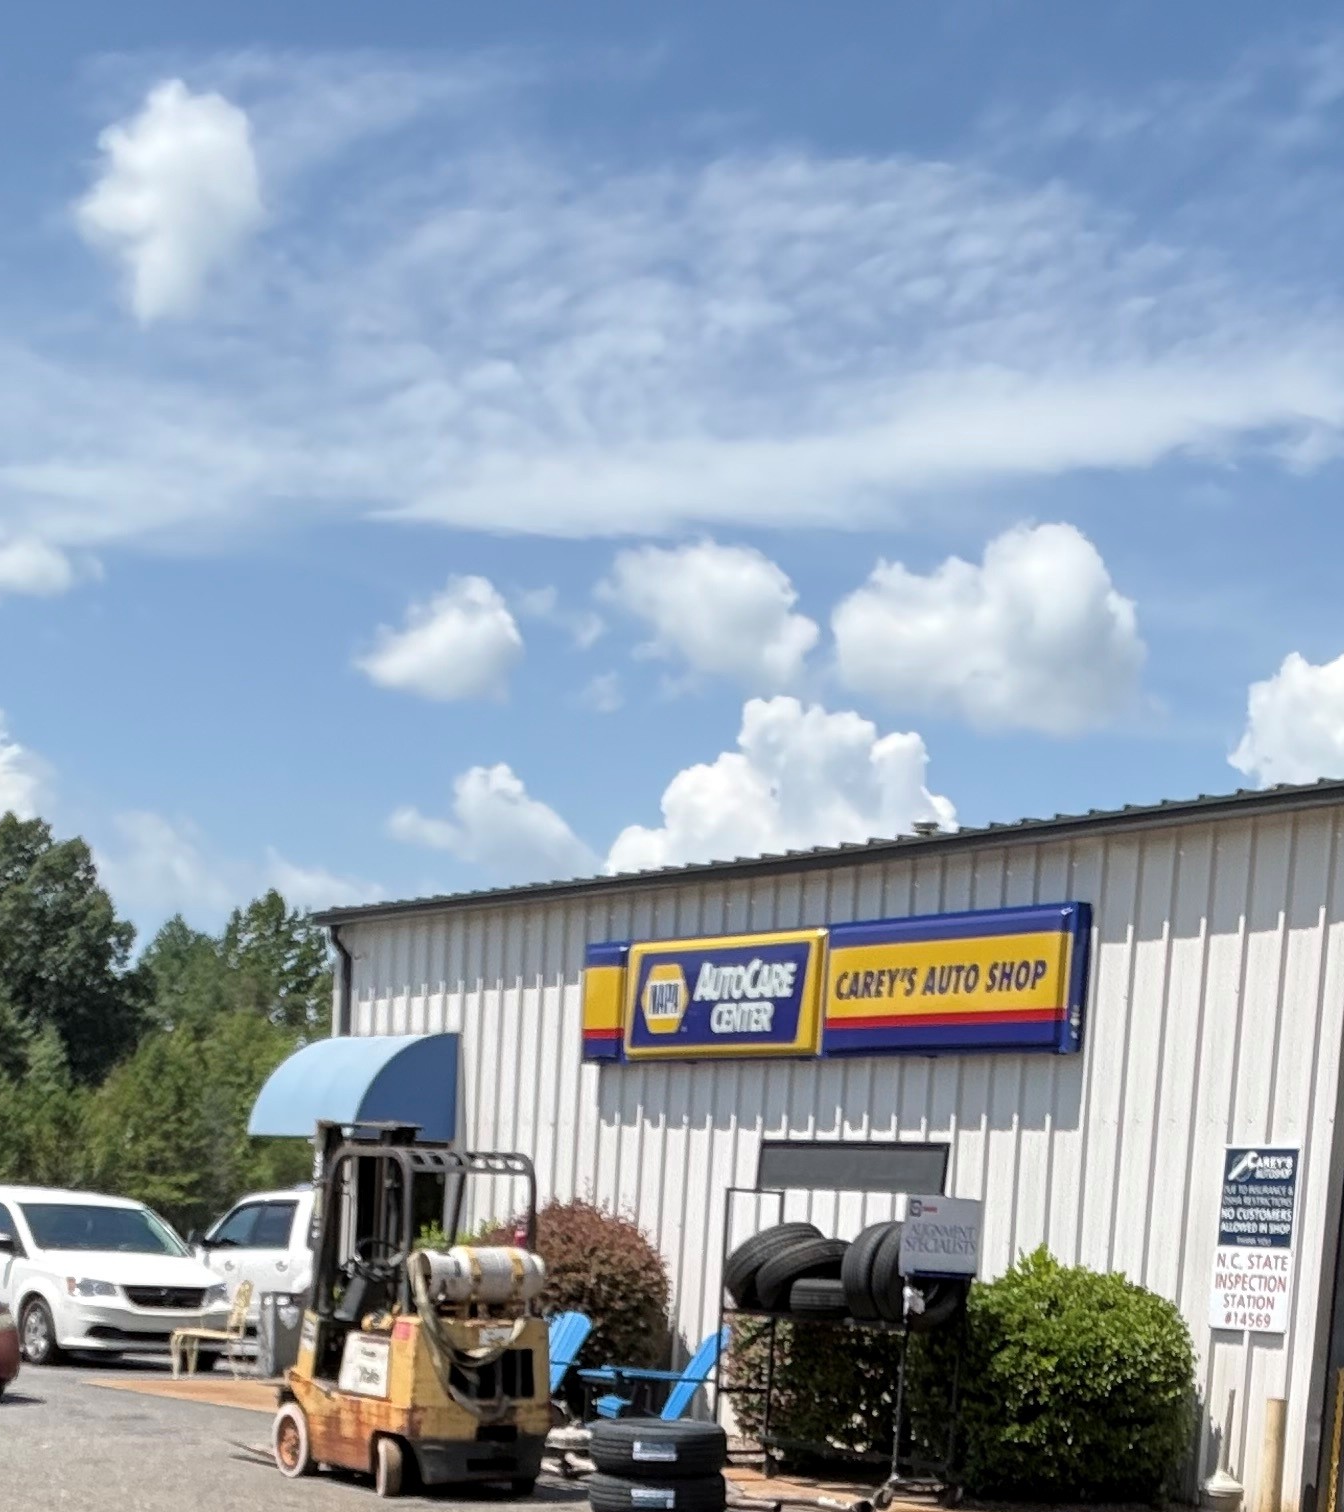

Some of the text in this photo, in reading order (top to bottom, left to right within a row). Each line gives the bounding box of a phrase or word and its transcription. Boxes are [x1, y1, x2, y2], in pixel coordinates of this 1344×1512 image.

[836, 959, 1047, 1000] CAREY'S AUTO SHOP
[650, 983, 679, 1014] NAPA
[711, 1001, 775, 1033] CENTER
[1247, 1152, 1293, 1169] CAREY'S
[1221, 1207, 1292, 1221] NO CUSTOMERS
[1220, 1221, 1291, 1234] ALLOWED IN SHOP
[1217, 1253, 1288, 1271] N.C. STATE
[1215, 1272, 1287, 1293] INSPECTION
[1223, 1293, 1275, 1310] STATION
[1225, 1311, 1271, 1328] #14569
